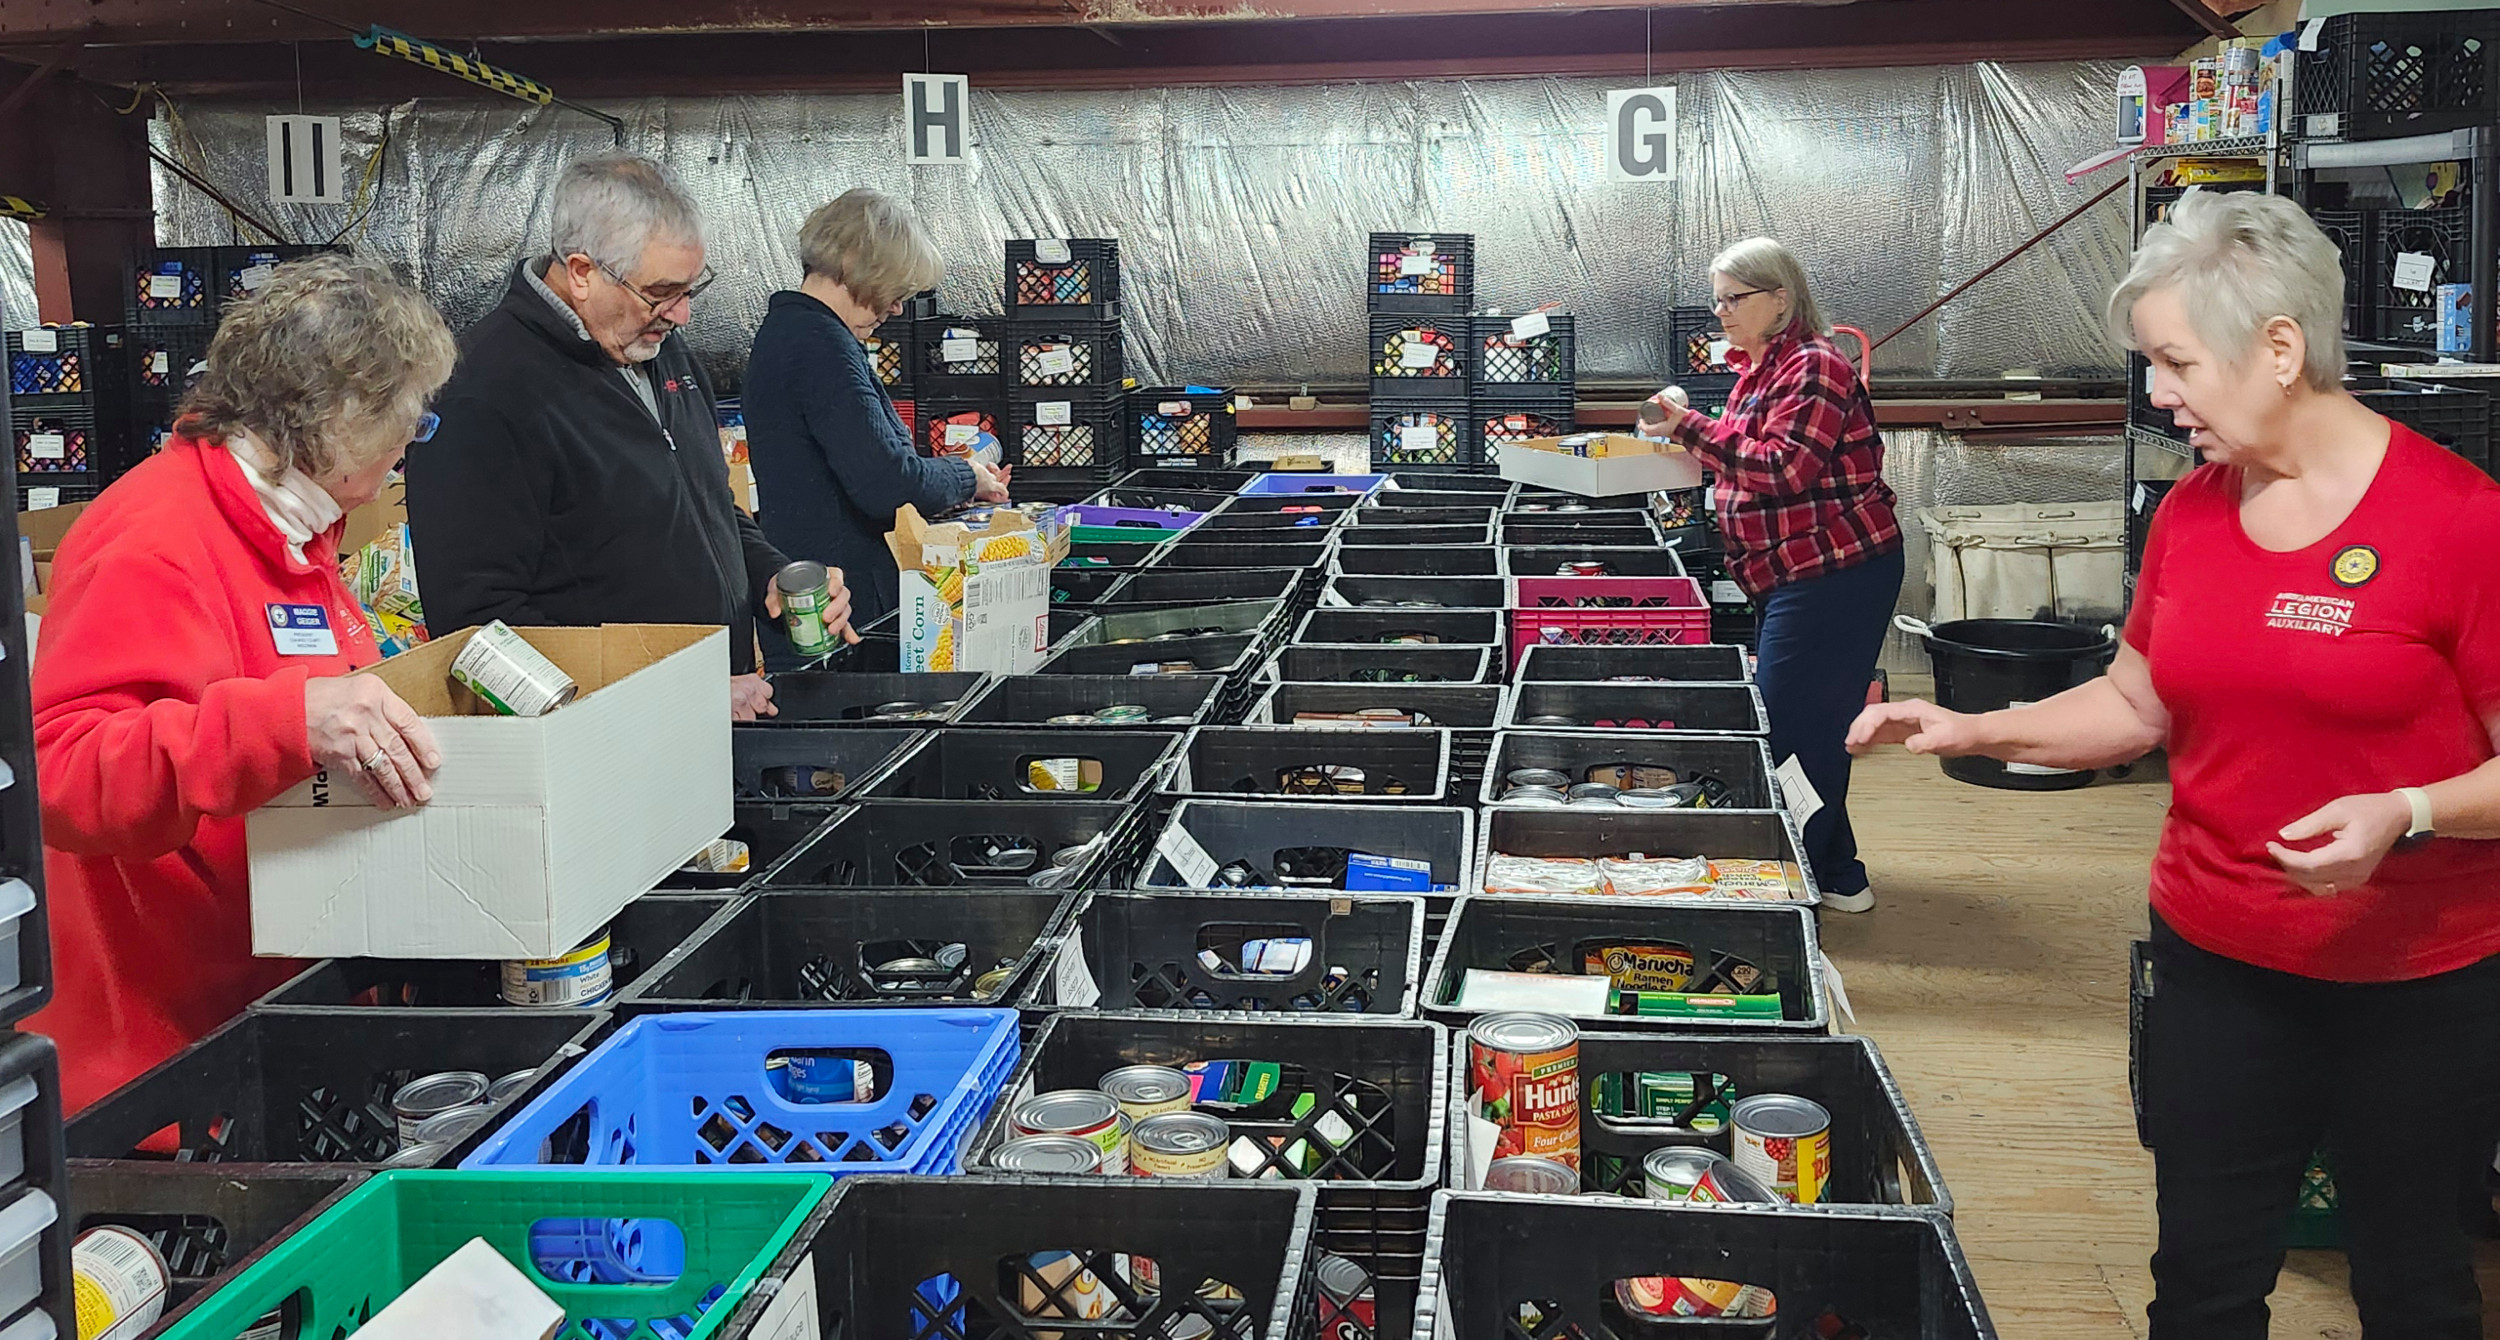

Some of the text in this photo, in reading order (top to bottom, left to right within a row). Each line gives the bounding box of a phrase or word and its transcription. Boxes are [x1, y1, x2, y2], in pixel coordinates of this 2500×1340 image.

[912, 81, 961, 158] H
[1617, 94, 1667, 176] G
[2270, 600, 2353, 623] LEGION
[912, 596, 925, 673] eet Corn
[2267, 617, 2346, 637] AUXILIARY
[580, 972, 600, 984] White
[1633, 972, 1674, 986] Ramen
[789, 1057, 815, 1067] arin
[1533, 1109, 1561, 1121] PASTA
[1534, 1135, 1558, 1148] Four
